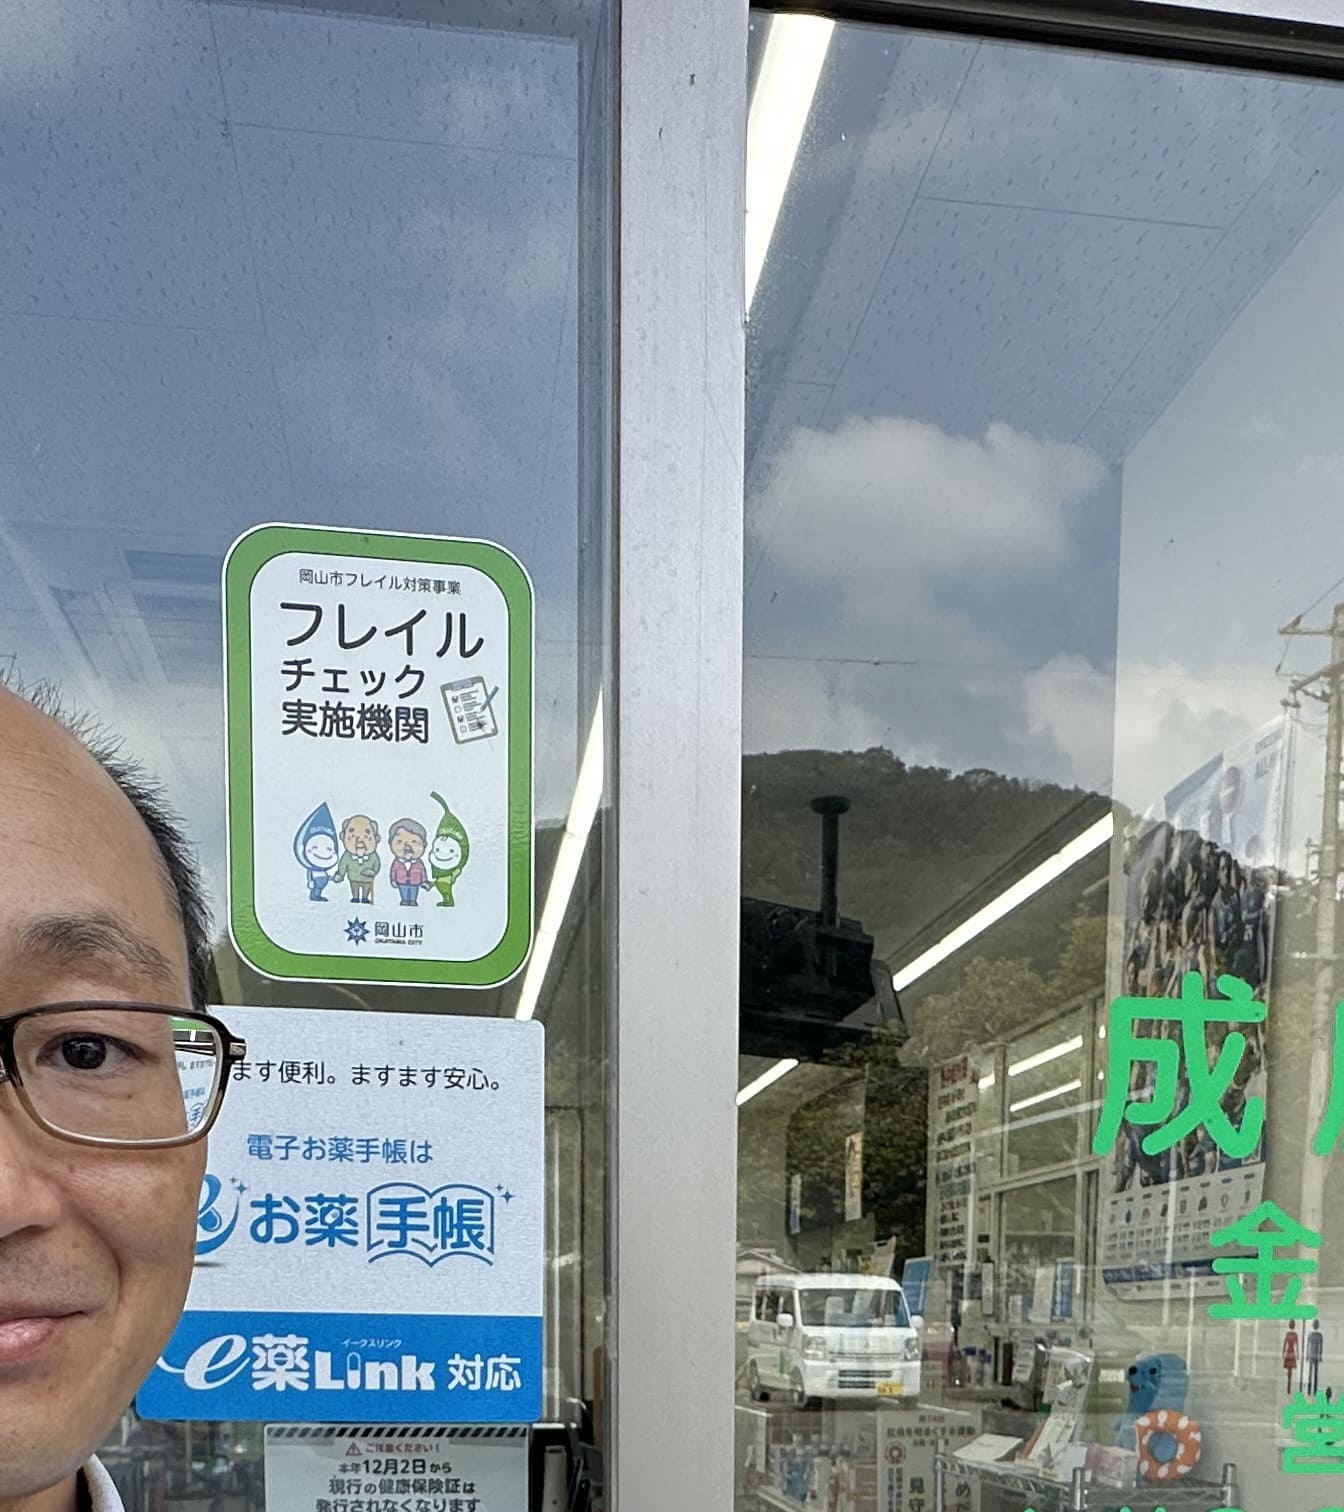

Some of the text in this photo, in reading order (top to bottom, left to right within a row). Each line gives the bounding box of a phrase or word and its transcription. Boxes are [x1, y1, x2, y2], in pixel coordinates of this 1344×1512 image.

[298, 568, 462, 596] 岡山市フレイル対策事業
[279, 601, 485, 660] フレイル
[280, 658, 425, 700] チェック
[281, 699, 429, 745] 実施機関
[374, 920, 425, 939] 岡山市
[246, 1134, 434, 1163] 電子お薬手帳は
[447, 1353, 522, 1391] 対応
[328, 1478, 476, 1495] 現行の健康保険証は
